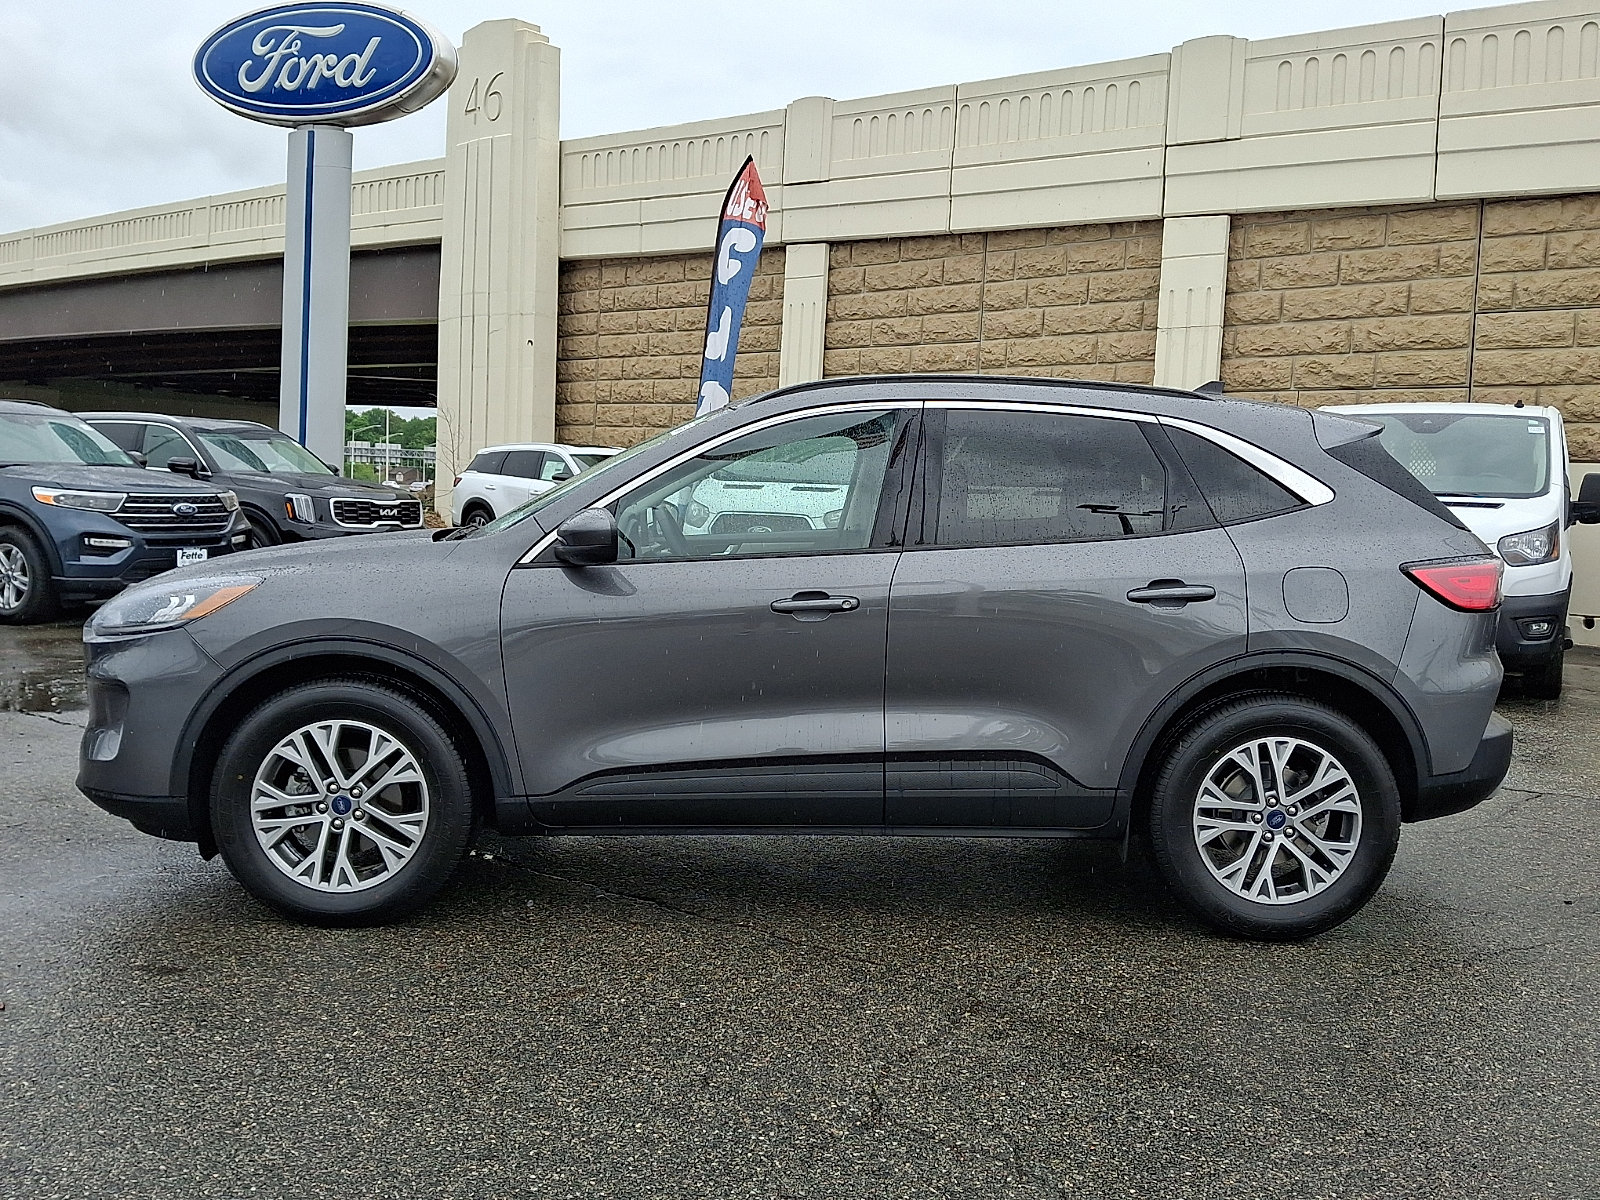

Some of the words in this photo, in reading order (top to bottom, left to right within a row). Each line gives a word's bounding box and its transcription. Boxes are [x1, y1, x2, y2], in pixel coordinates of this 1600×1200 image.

[238, 23, 382, 92] Ford
[464, 71, 505, 126] 46
[380, 508, 398, 517] KIA
[181, 551, 203, 560] Fette
